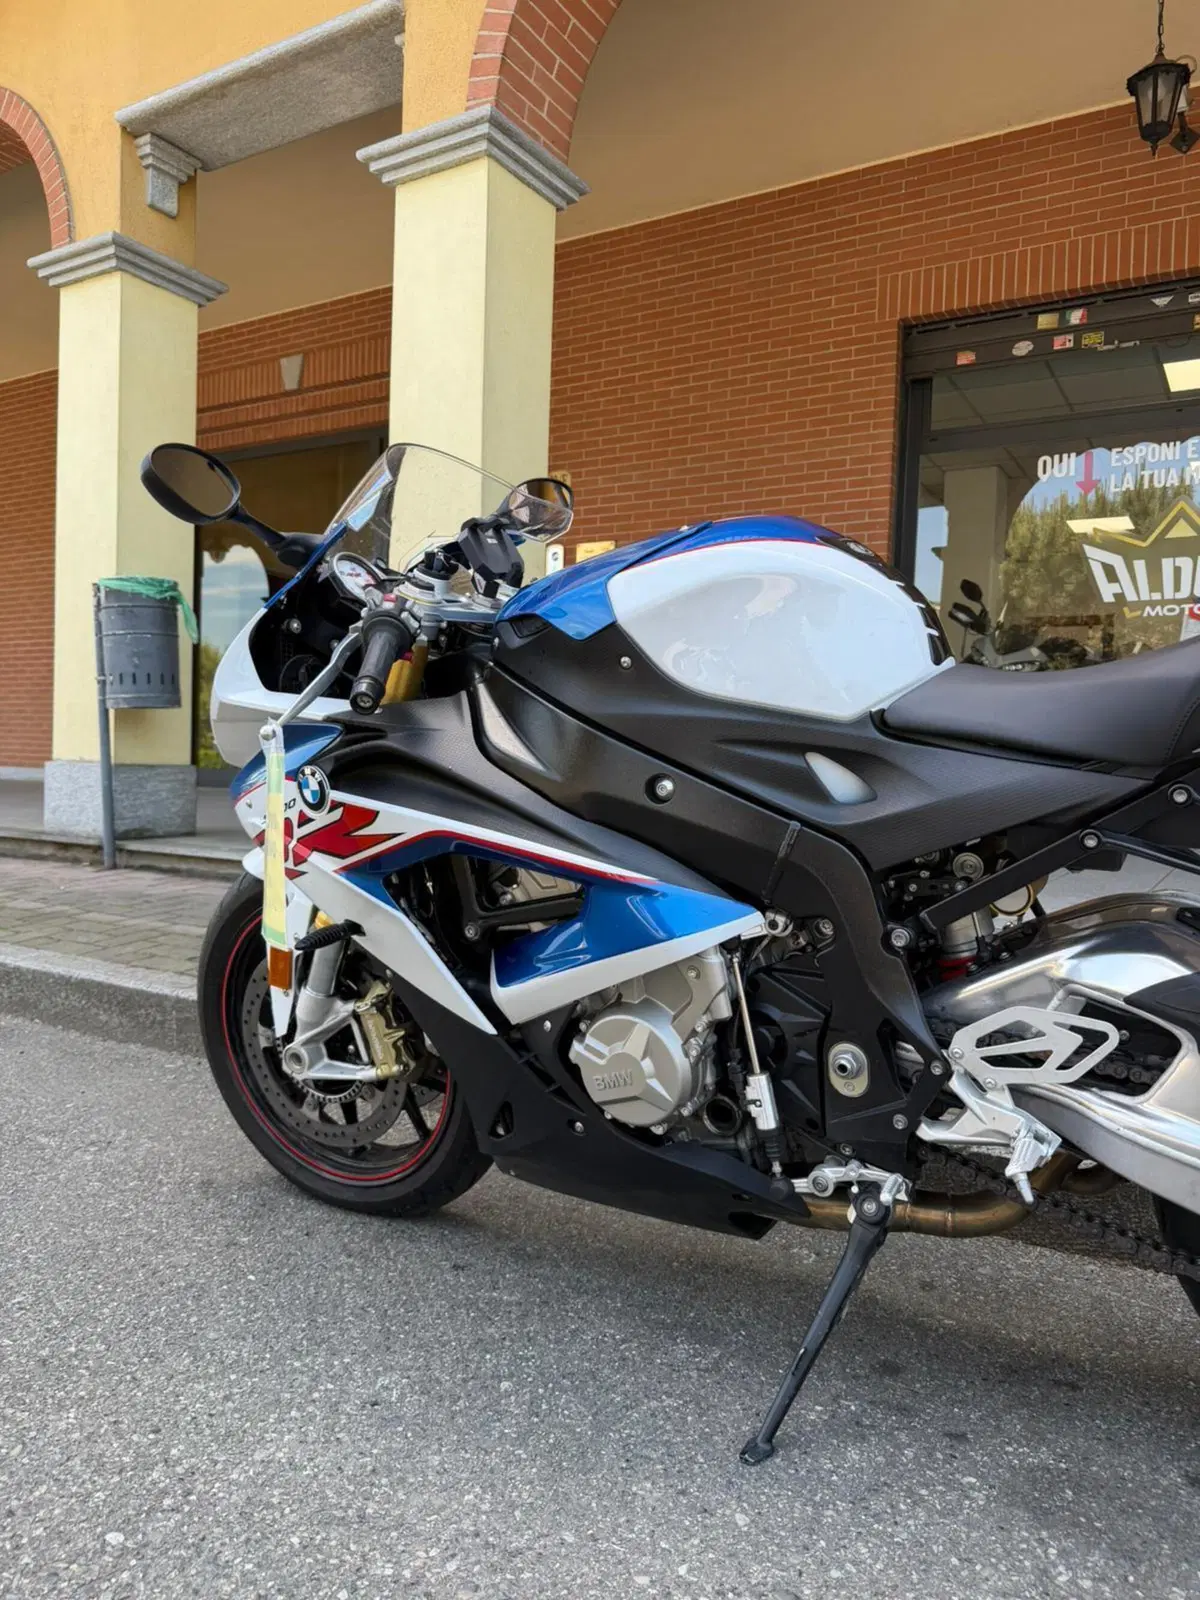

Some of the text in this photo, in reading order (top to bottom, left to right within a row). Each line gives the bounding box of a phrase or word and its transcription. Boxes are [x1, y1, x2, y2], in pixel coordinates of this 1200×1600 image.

[1037, 452, 1077, 482] QUI
[1111, 441, 1181, 467] ESPONI
[1110, 472, 1135, 492] LA
[1141, 467, 1179, 489] TUA
[1082, 543, 1200, 603] ALD
[592, 1069, 633, 1092] BMW
